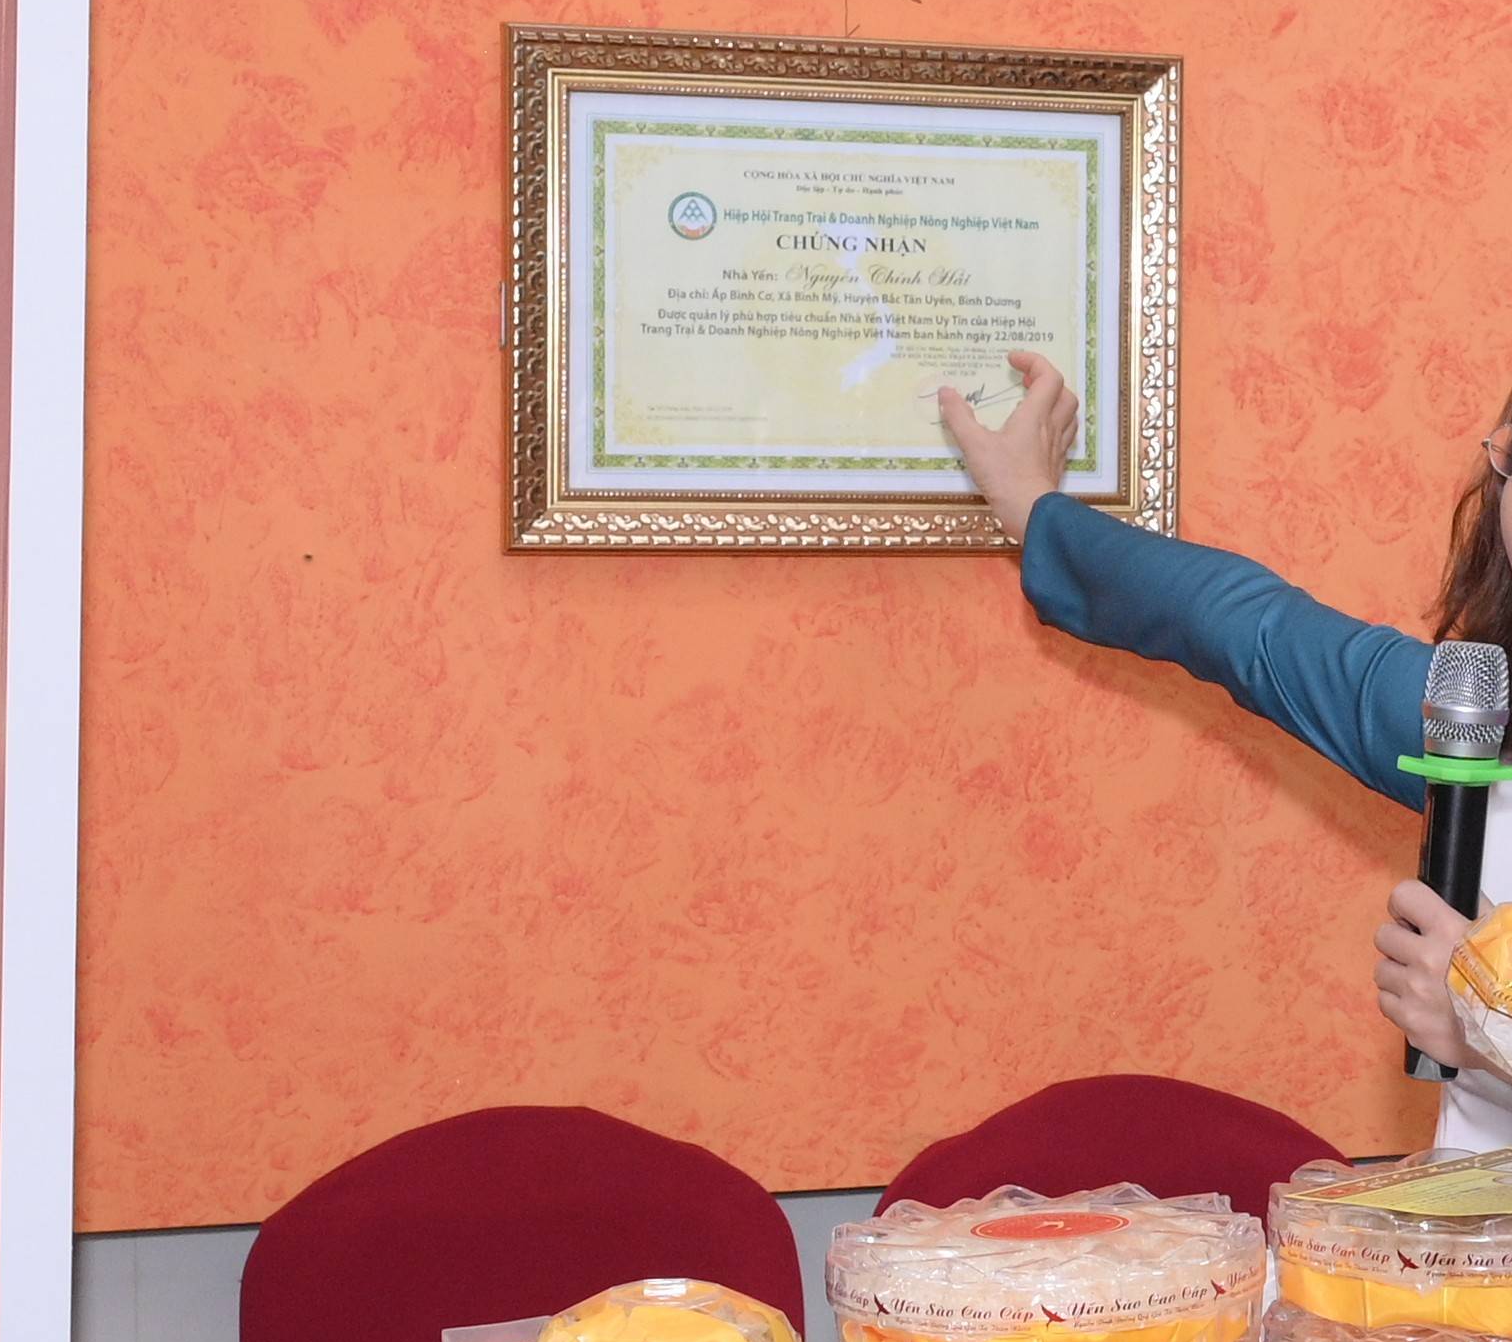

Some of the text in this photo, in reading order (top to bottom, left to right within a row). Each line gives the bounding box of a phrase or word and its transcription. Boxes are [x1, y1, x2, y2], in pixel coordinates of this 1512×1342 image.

[773, 211, 804, 226] Trang
[828, 213, 837, 224] &
[840, 212, 875, 226] Doanh
[1015, 219, 1040, 230] Nam
[776, 232, 927, 257] CHỨNG NHẬN
[641, 323, 672, 337] Trang
[697, 324, 706, 336] &
[708, 325, 745, 336] Doanh
[886, 329, 911, 340] Nam
[913, 329, 934, 341] ban
